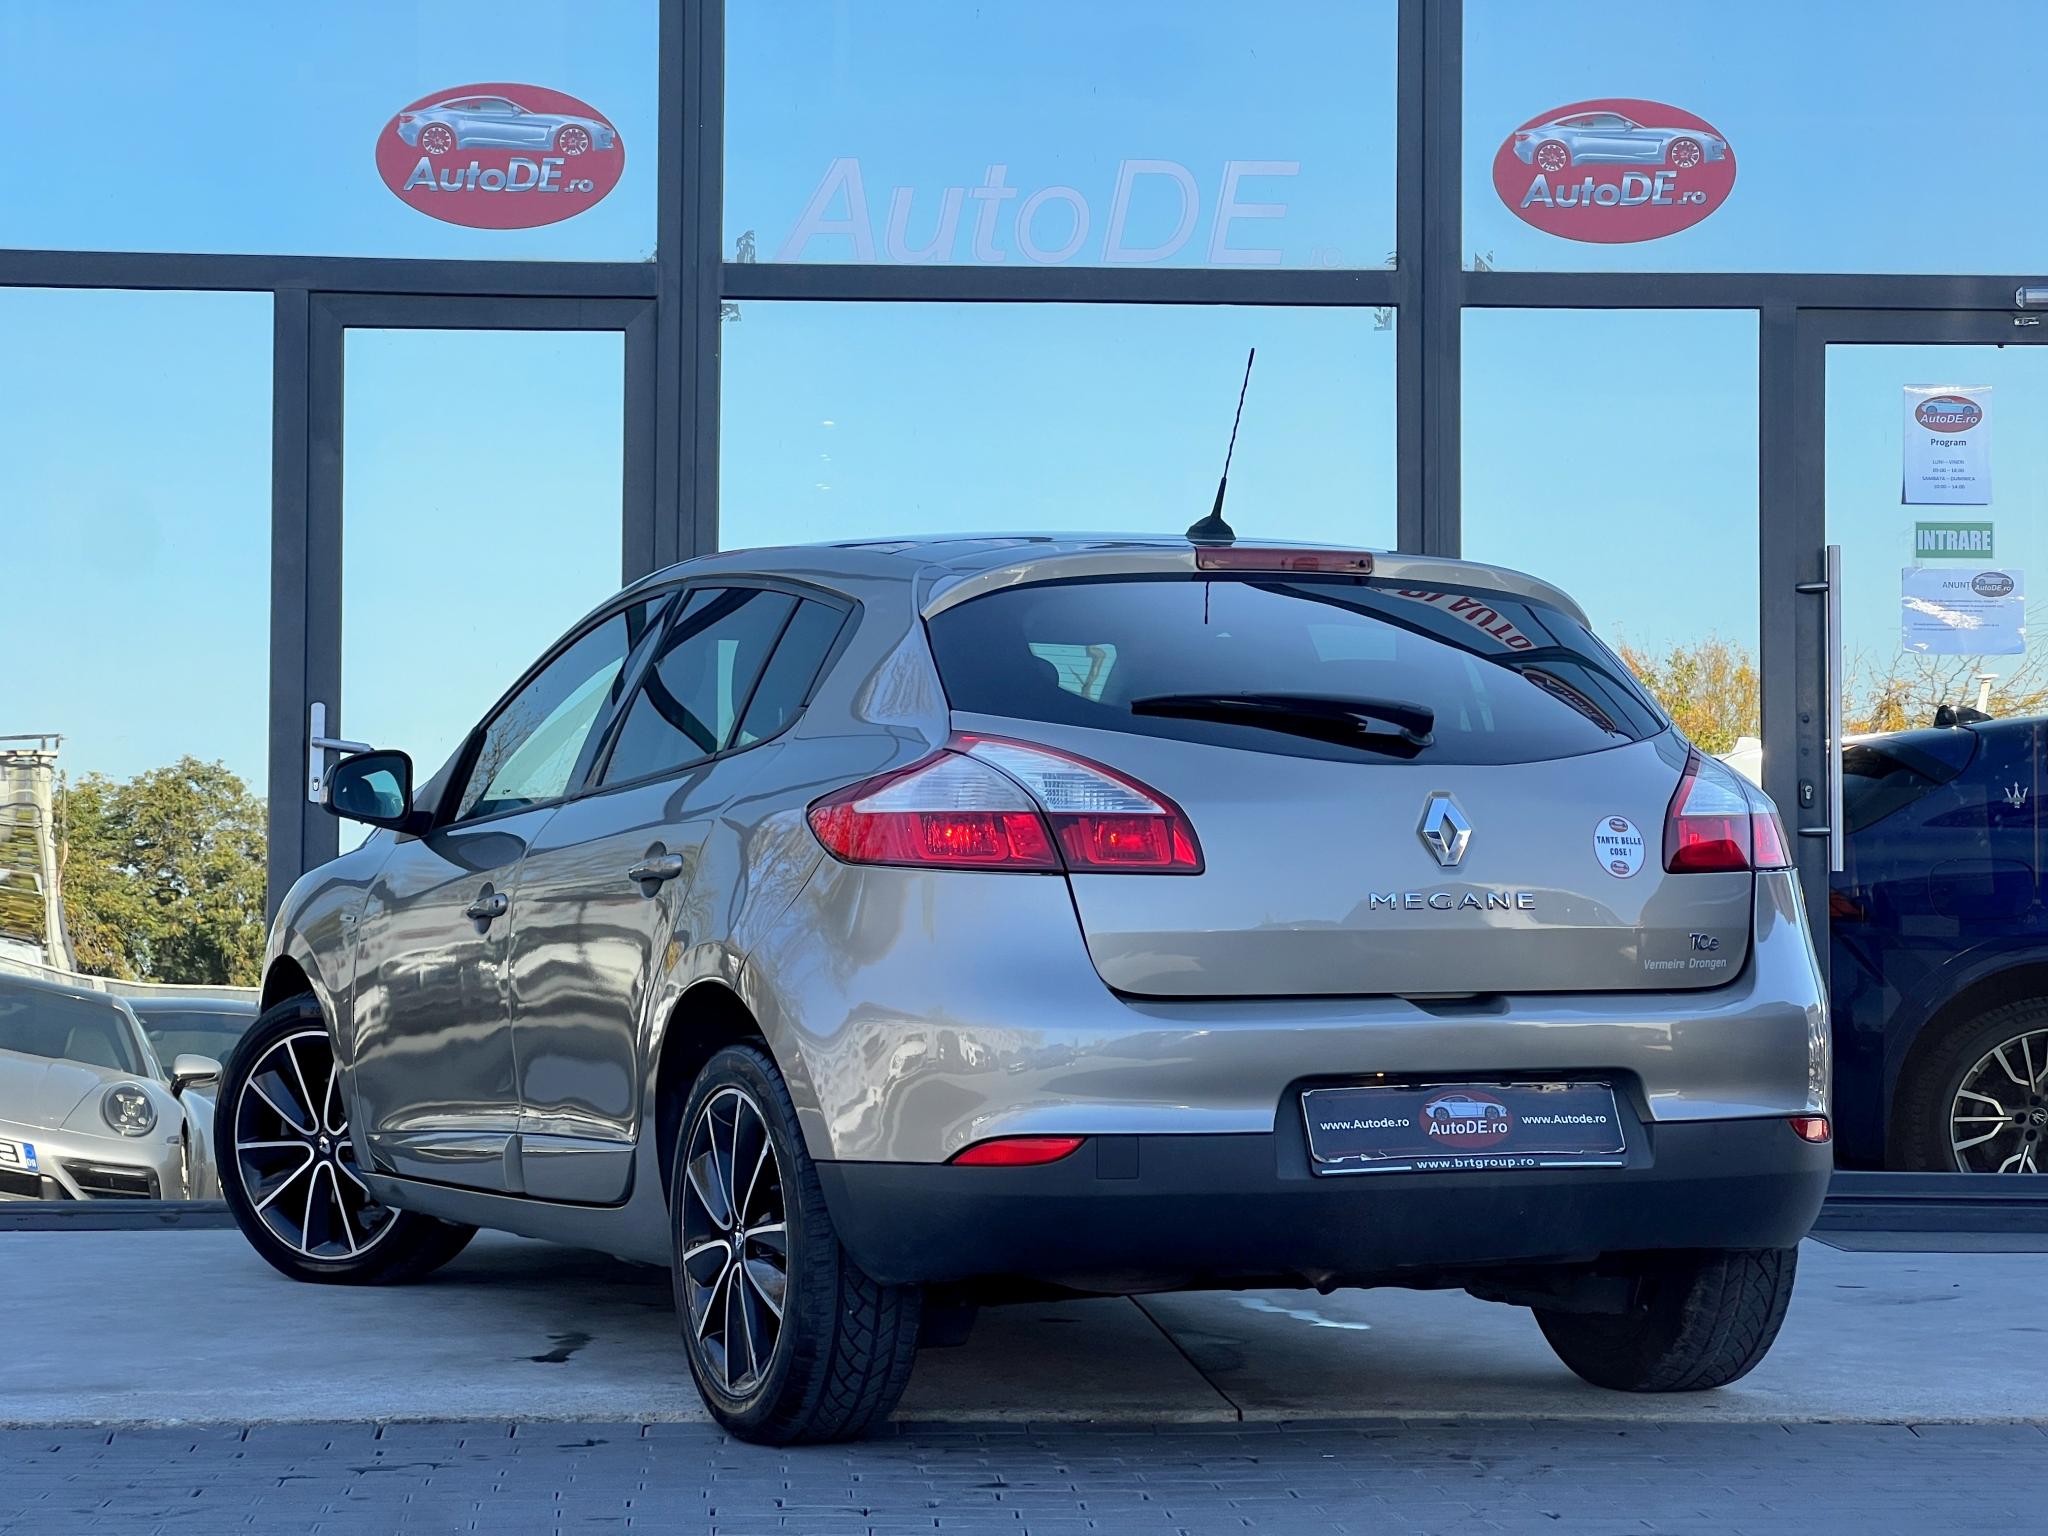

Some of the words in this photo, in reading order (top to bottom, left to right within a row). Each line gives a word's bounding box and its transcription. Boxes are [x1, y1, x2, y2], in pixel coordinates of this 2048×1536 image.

[1919, 414, 1978, 424] AutoDE.ro
[1930, 438, 1967, 447] Program
[1917, 530, 1991, 551] INTRARE
[1596, 836, 1619, 845] TANTE
[1620, 837, 1642, 846] BELLE
[1609, 848, 1627, 856] COSE
[1368, 892, 1536, 911] MEGANE
[1688, 932, 1720, 952] TCe
[1643, 958, 1685, 970] Vermeire
[1320, 1117, 1410, 1131] www.Autode.ro
[1428, 1119, 1509, 1136] AutoDE.ro
[1521, 1113, 1607, 1126] www.Autode.ro
[1416, 1156, 1535, 1170] www.brtgroup.ro
